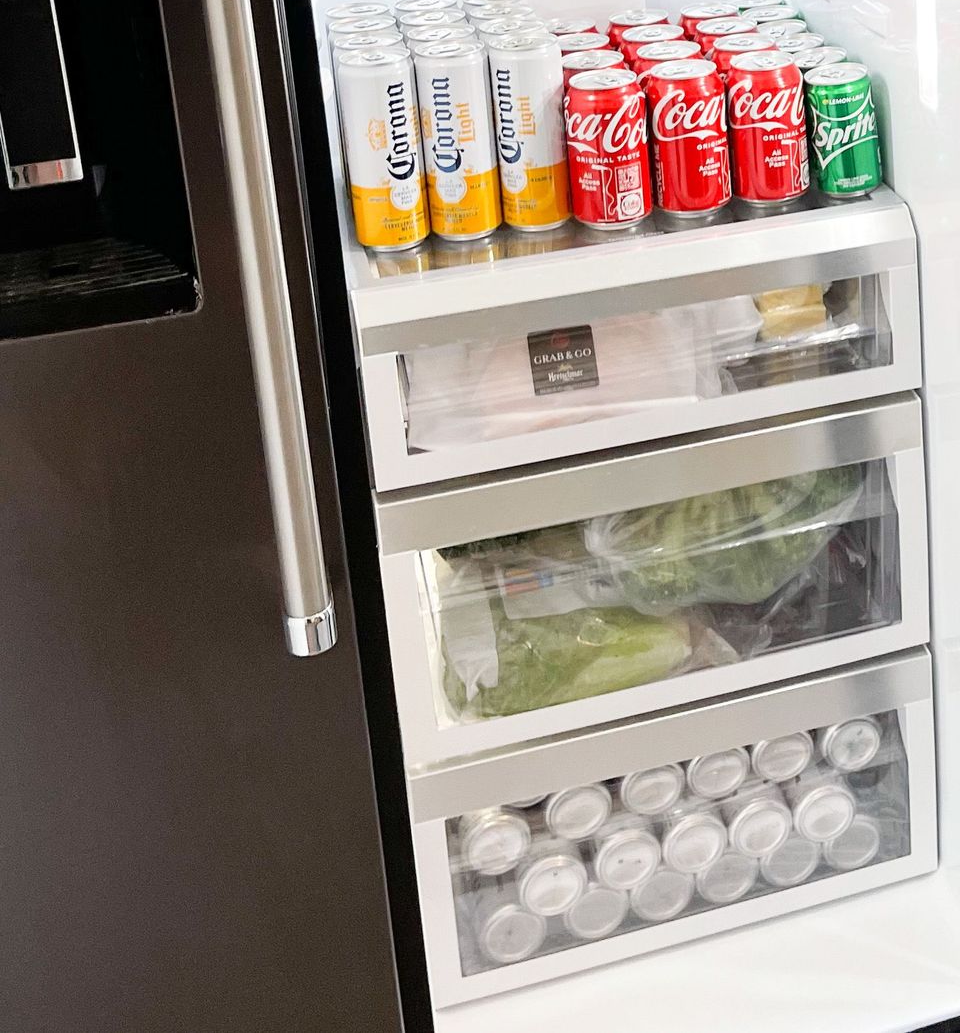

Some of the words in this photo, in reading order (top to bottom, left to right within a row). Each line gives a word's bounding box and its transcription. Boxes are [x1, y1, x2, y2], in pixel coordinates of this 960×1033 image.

[386, 81, 416, 180] Corona
[431, 77, 464, 173] Corona
[456, 103, 476, 143] Light
[496, 69, 524, 164] Corona
[516, 96, 536, 136] Light
[762, 130, 800, 141] ORIGINAL
[815, 111, 876, 151] Sprite
[576, 154, 615, 165] ORIGINAL
[616, 151, 641, 163] TASTE
[699, 163, 721, 173] Access
[765, 155, 789, 163] Access
[534, 352, 564, 365] GRAB
[565, 350, 573, 360] &
[574, 348, 592, 358] GO
